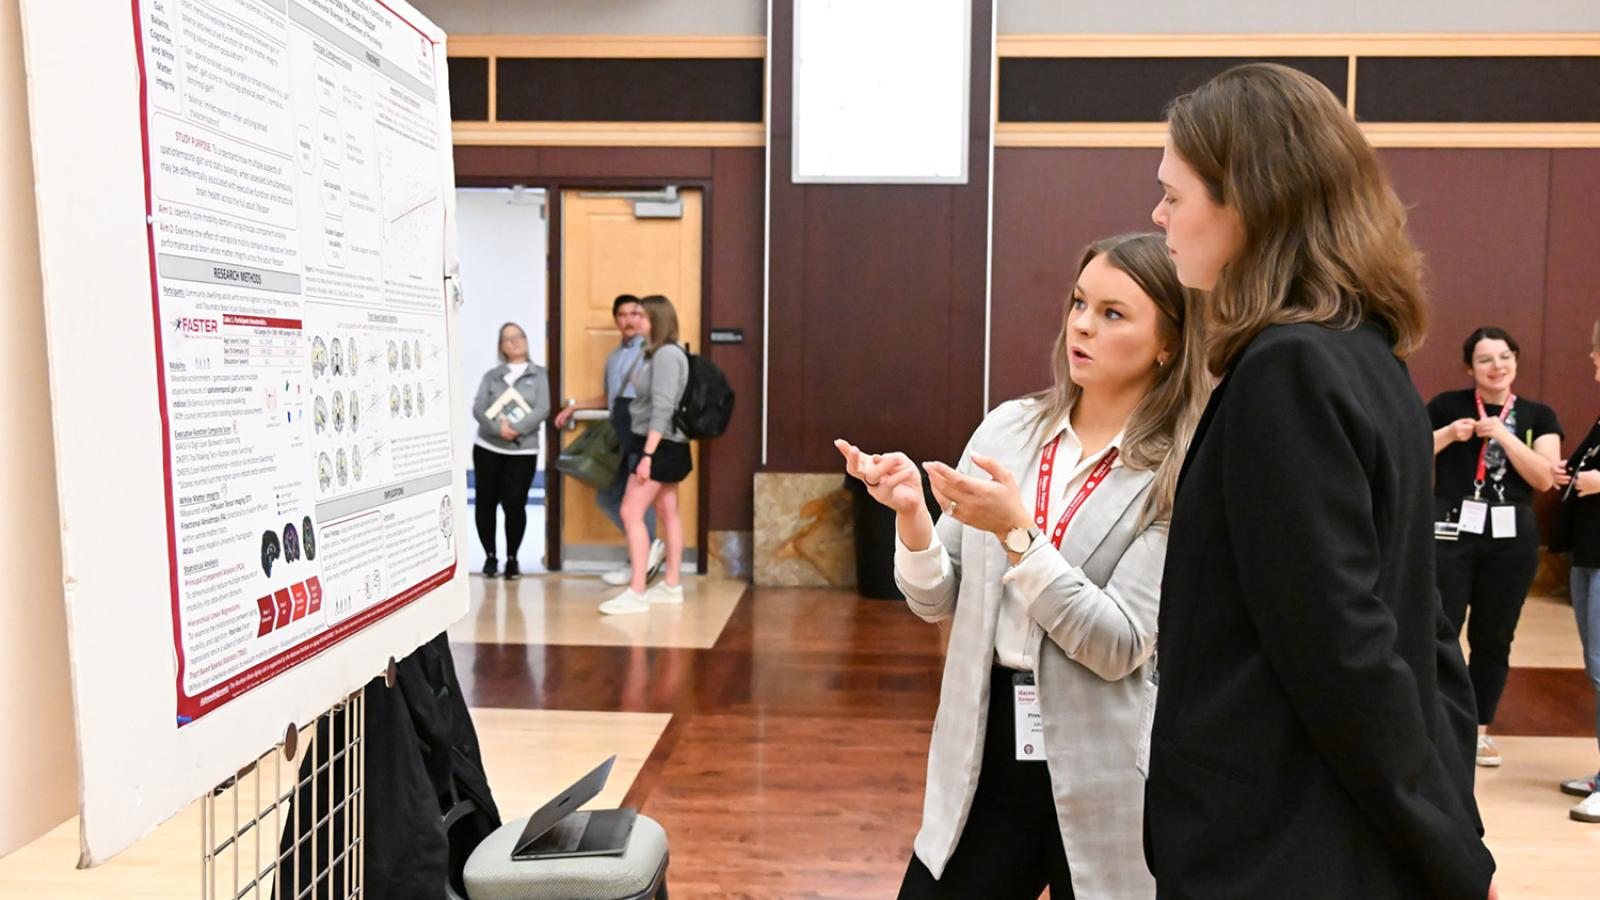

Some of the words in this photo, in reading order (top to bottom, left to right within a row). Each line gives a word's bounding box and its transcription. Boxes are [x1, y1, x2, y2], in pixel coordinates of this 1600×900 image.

[150, 14, 169, 31] Balance,
[149, 28, 172, 48] Cognition,
[151, 44, 160, 56] and
[161, 49, 174, 62] White
[156, 61, 172, 75] Matter
[175, 131, 190, 144] STUDY
[158, 204, 168, 214] Aim
[159, 223, 169, 232] Aim
[213, 267, 239, 280] RESEARCH
[240, 270, 261, 283] METHODS
[182, 318, 218, 332] FASTER
[1093, 461, 1106, 478] Hayes
[1060, 506, 1074, 524] Hayes
[1070, 491, 1084, 508] Forum
